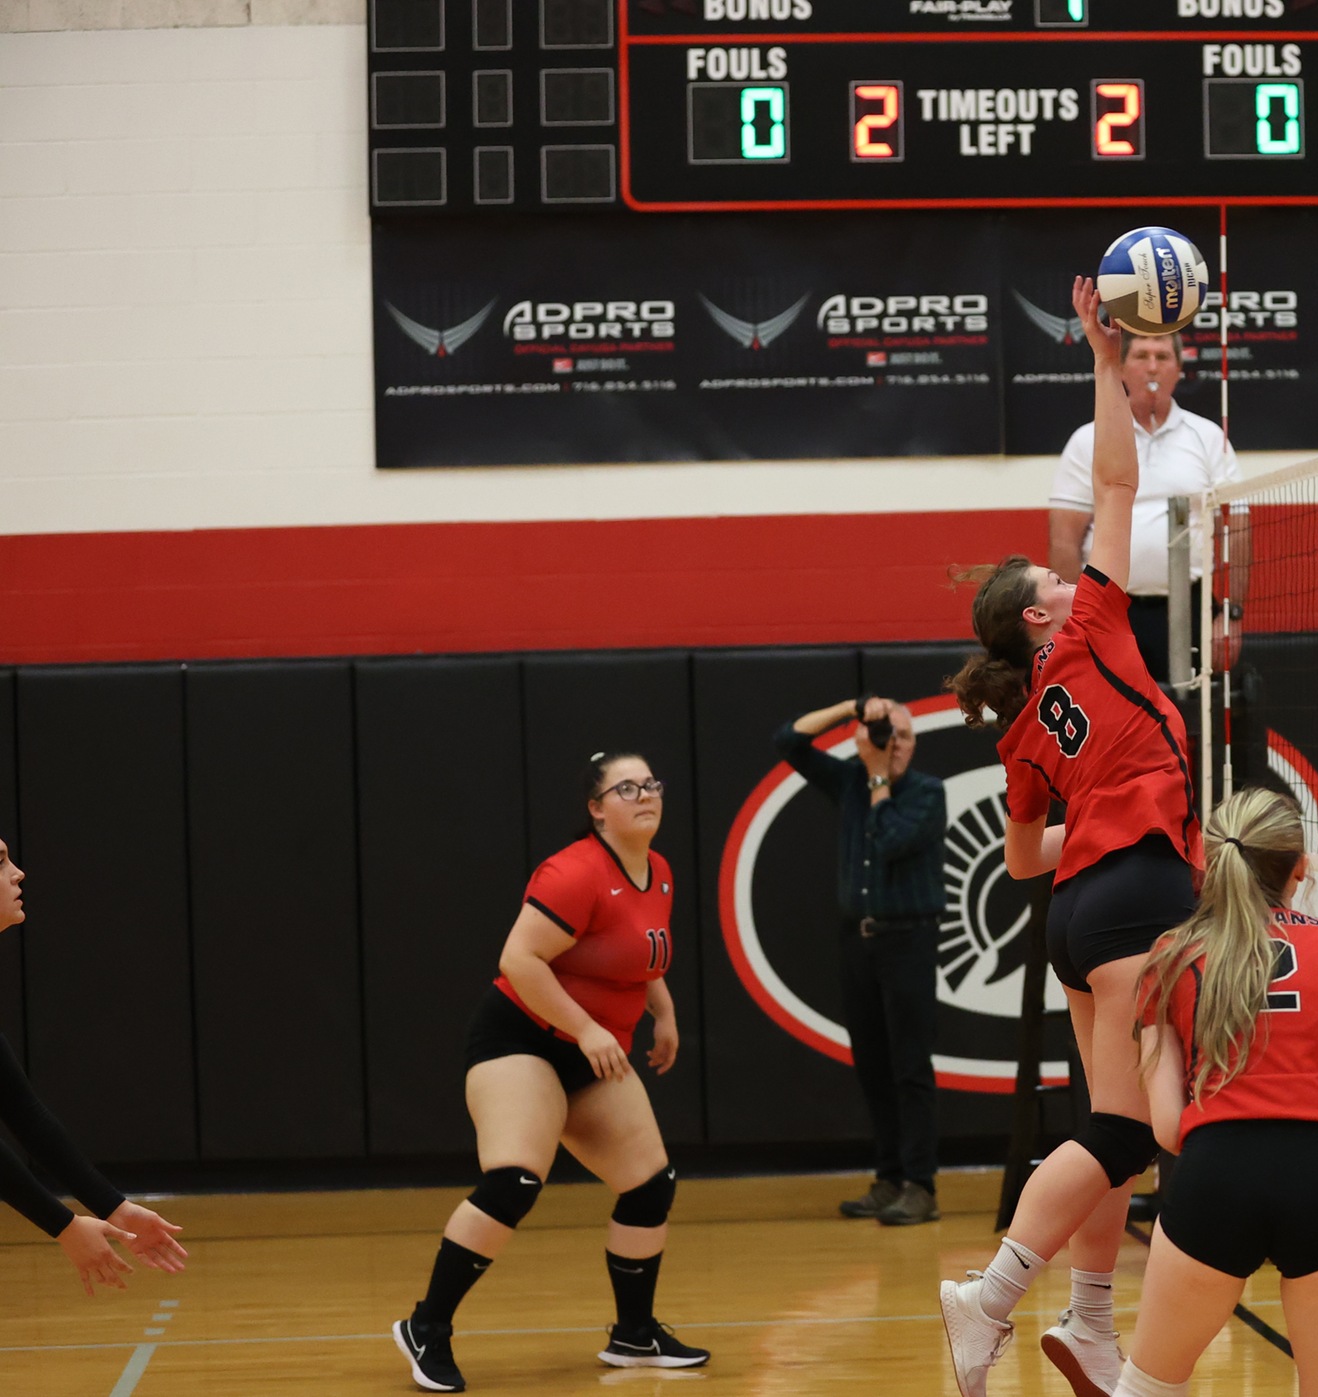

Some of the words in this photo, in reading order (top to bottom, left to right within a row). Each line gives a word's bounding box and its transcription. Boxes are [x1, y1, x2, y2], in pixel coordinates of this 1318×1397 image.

[703, 0, 813, 21] BONUS
[1177, 0, 1285, 18] BONUS
[686, 46, 788, 81] FOULS
[1202, 43, 1302, 77] FOULS
[855, 86, 898, 157] 2
[916, 87, 1080, 122] TIMEOUTS
[1096, 84, 1141, 155] 2
[1256, 84, 1300, 154] 0
[741, 87, 785, 159] 0
[959, 123, 1036, 156] LEFT
[1156, 247, 1179, 309] molten
[503, 300, 675, 328] ADPRO
[817, 294, 988, 321] ADPRO
[1202, 290, 1298, 311] PRO
[512, 321, 675, 341] SPORTS
[826, 315, 988, 335] SPORTS
[1193, 311, 1298, 328] ORTS
[1037, 684, 1090, 758] 8
[646, 928, 668, 972] 11
[1259, 937, 1301, 1012] 2
